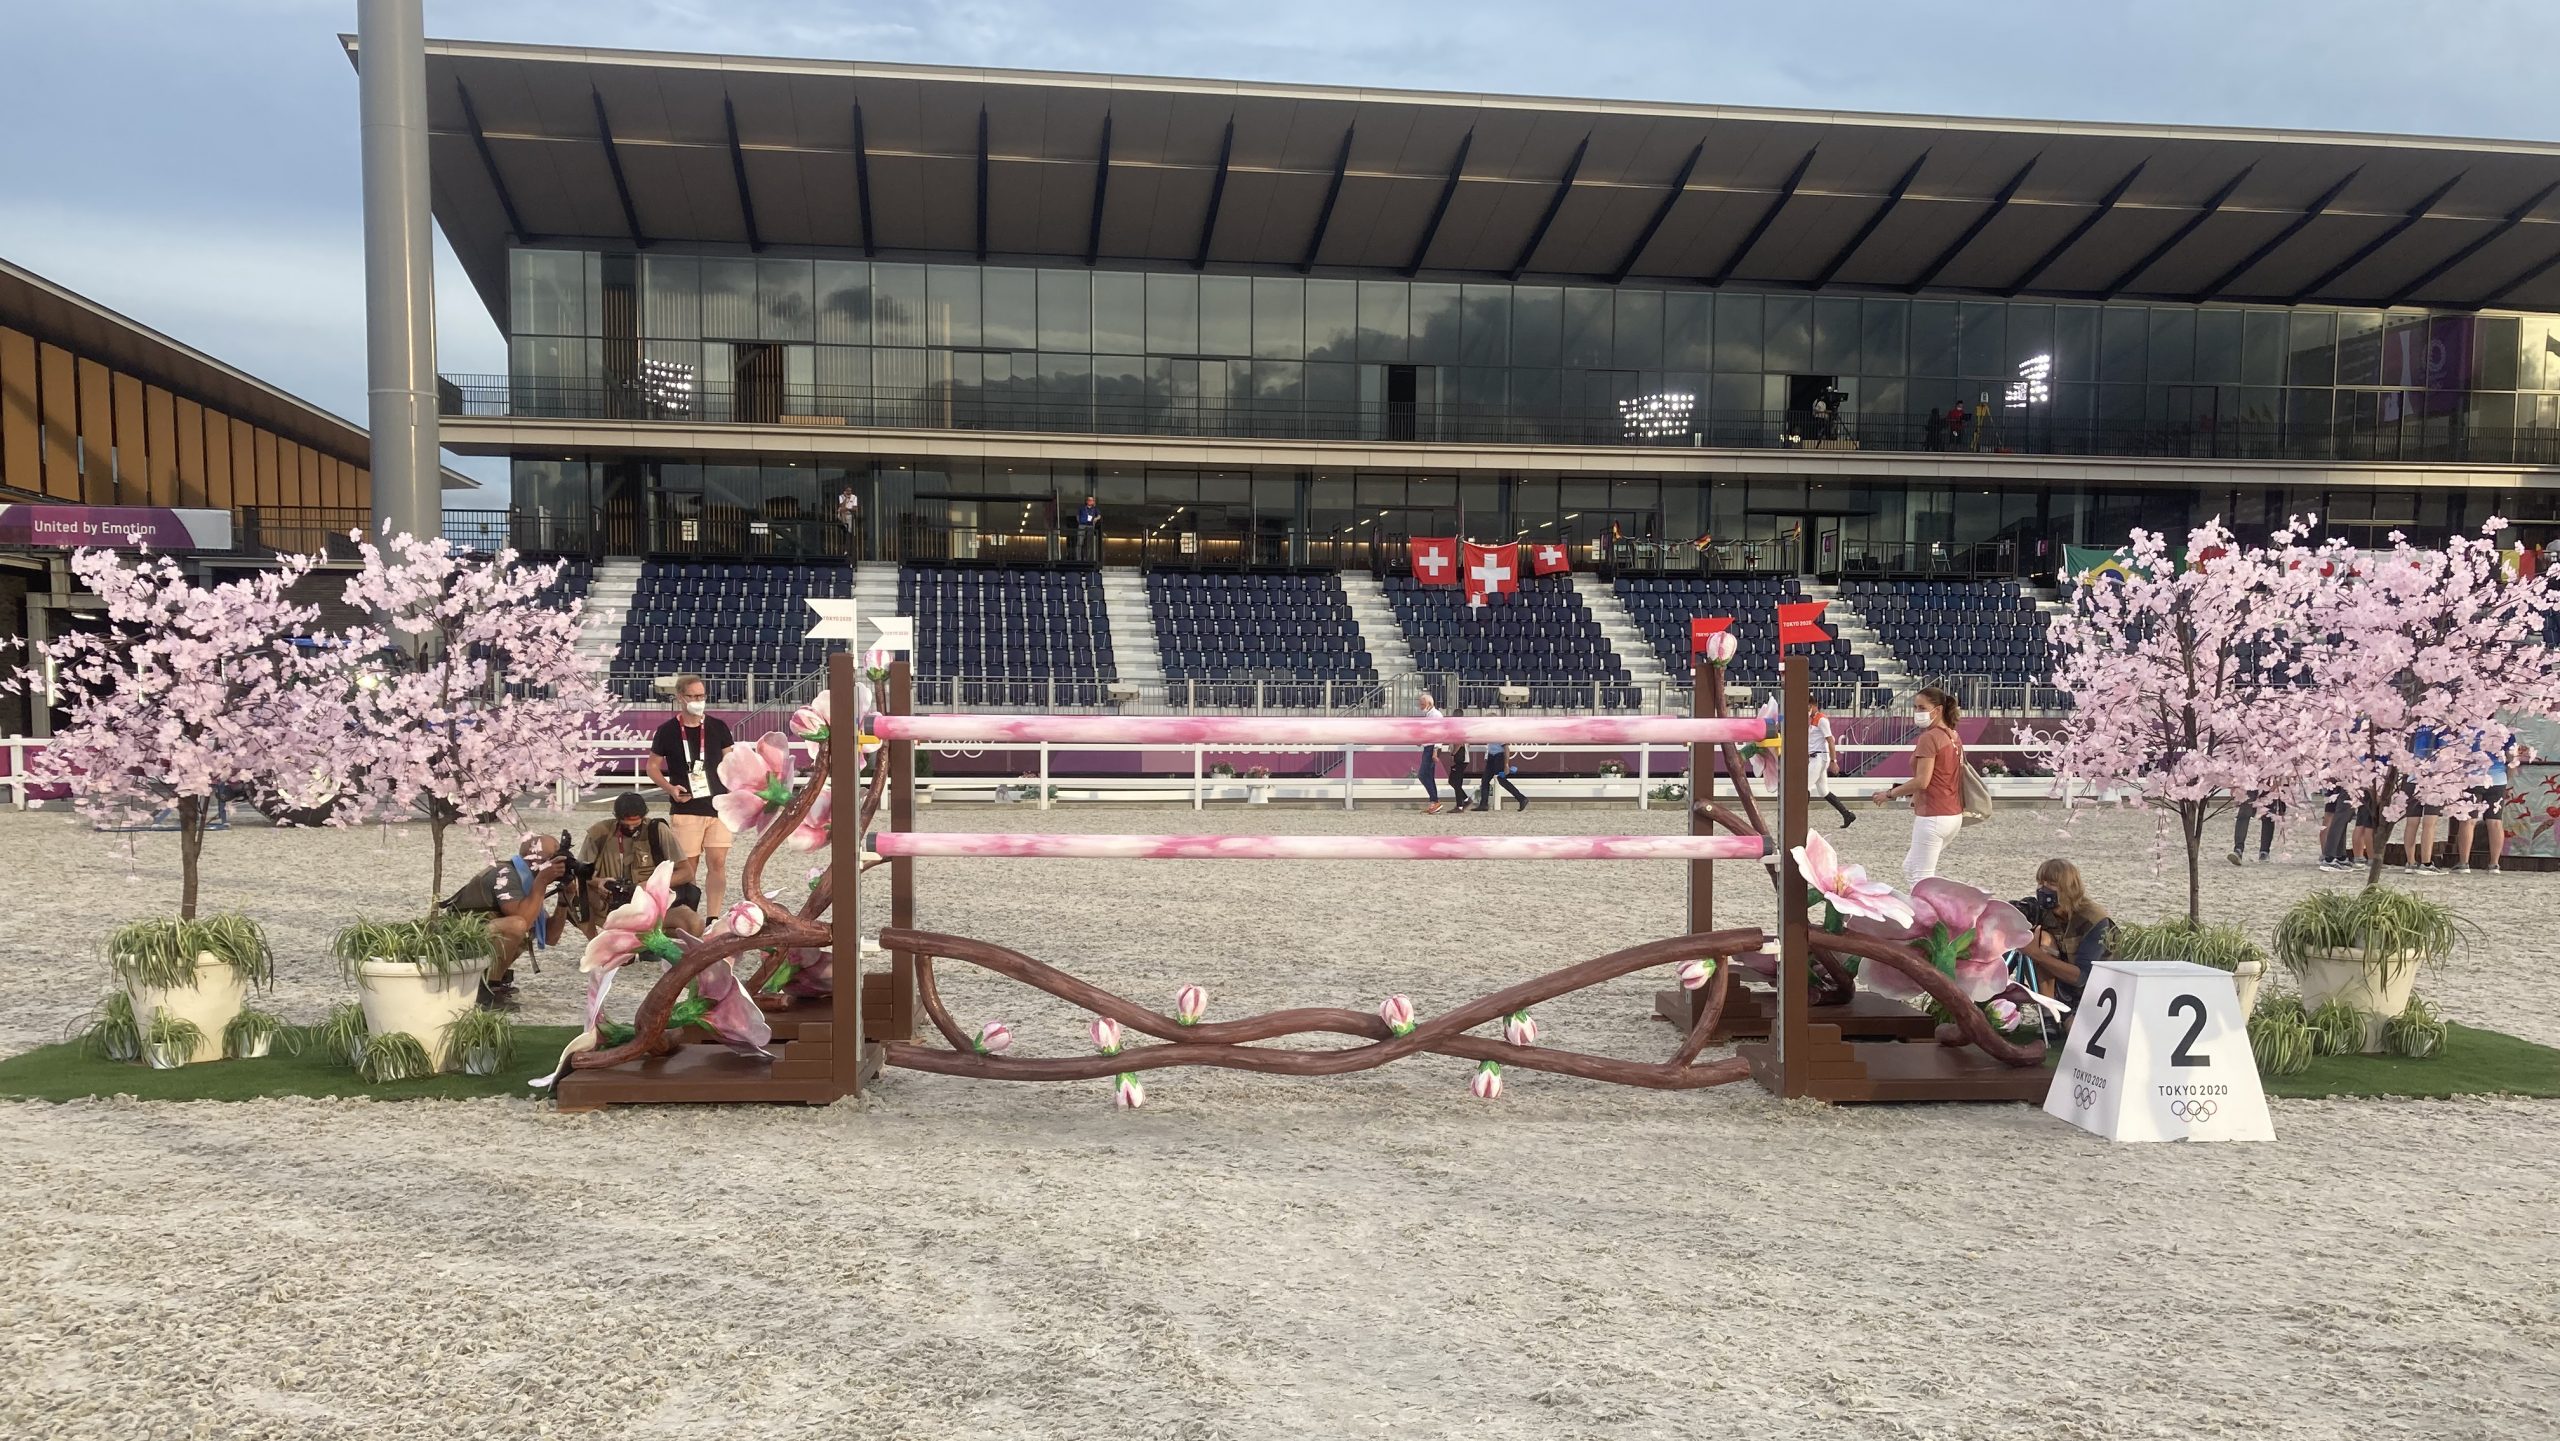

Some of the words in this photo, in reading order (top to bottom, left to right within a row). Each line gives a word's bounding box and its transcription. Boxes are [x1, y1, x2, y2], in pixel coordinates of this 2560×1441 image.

[34, 520, 78, 533] United
[83, 521, 98, 536] by
[102, 521, 156, 535] Emotion
[2085, 987, 2118, 1060] 2
[2167, 994, 2211, 1067] 2
[2073, 1067, 2092, 1084] TOKYO
[2091, 1074, 2107, 1090] 2020
[2158, 1085, 2197, 1096] TOKYO
[2199, 1084, 2228, 1096] 2020
